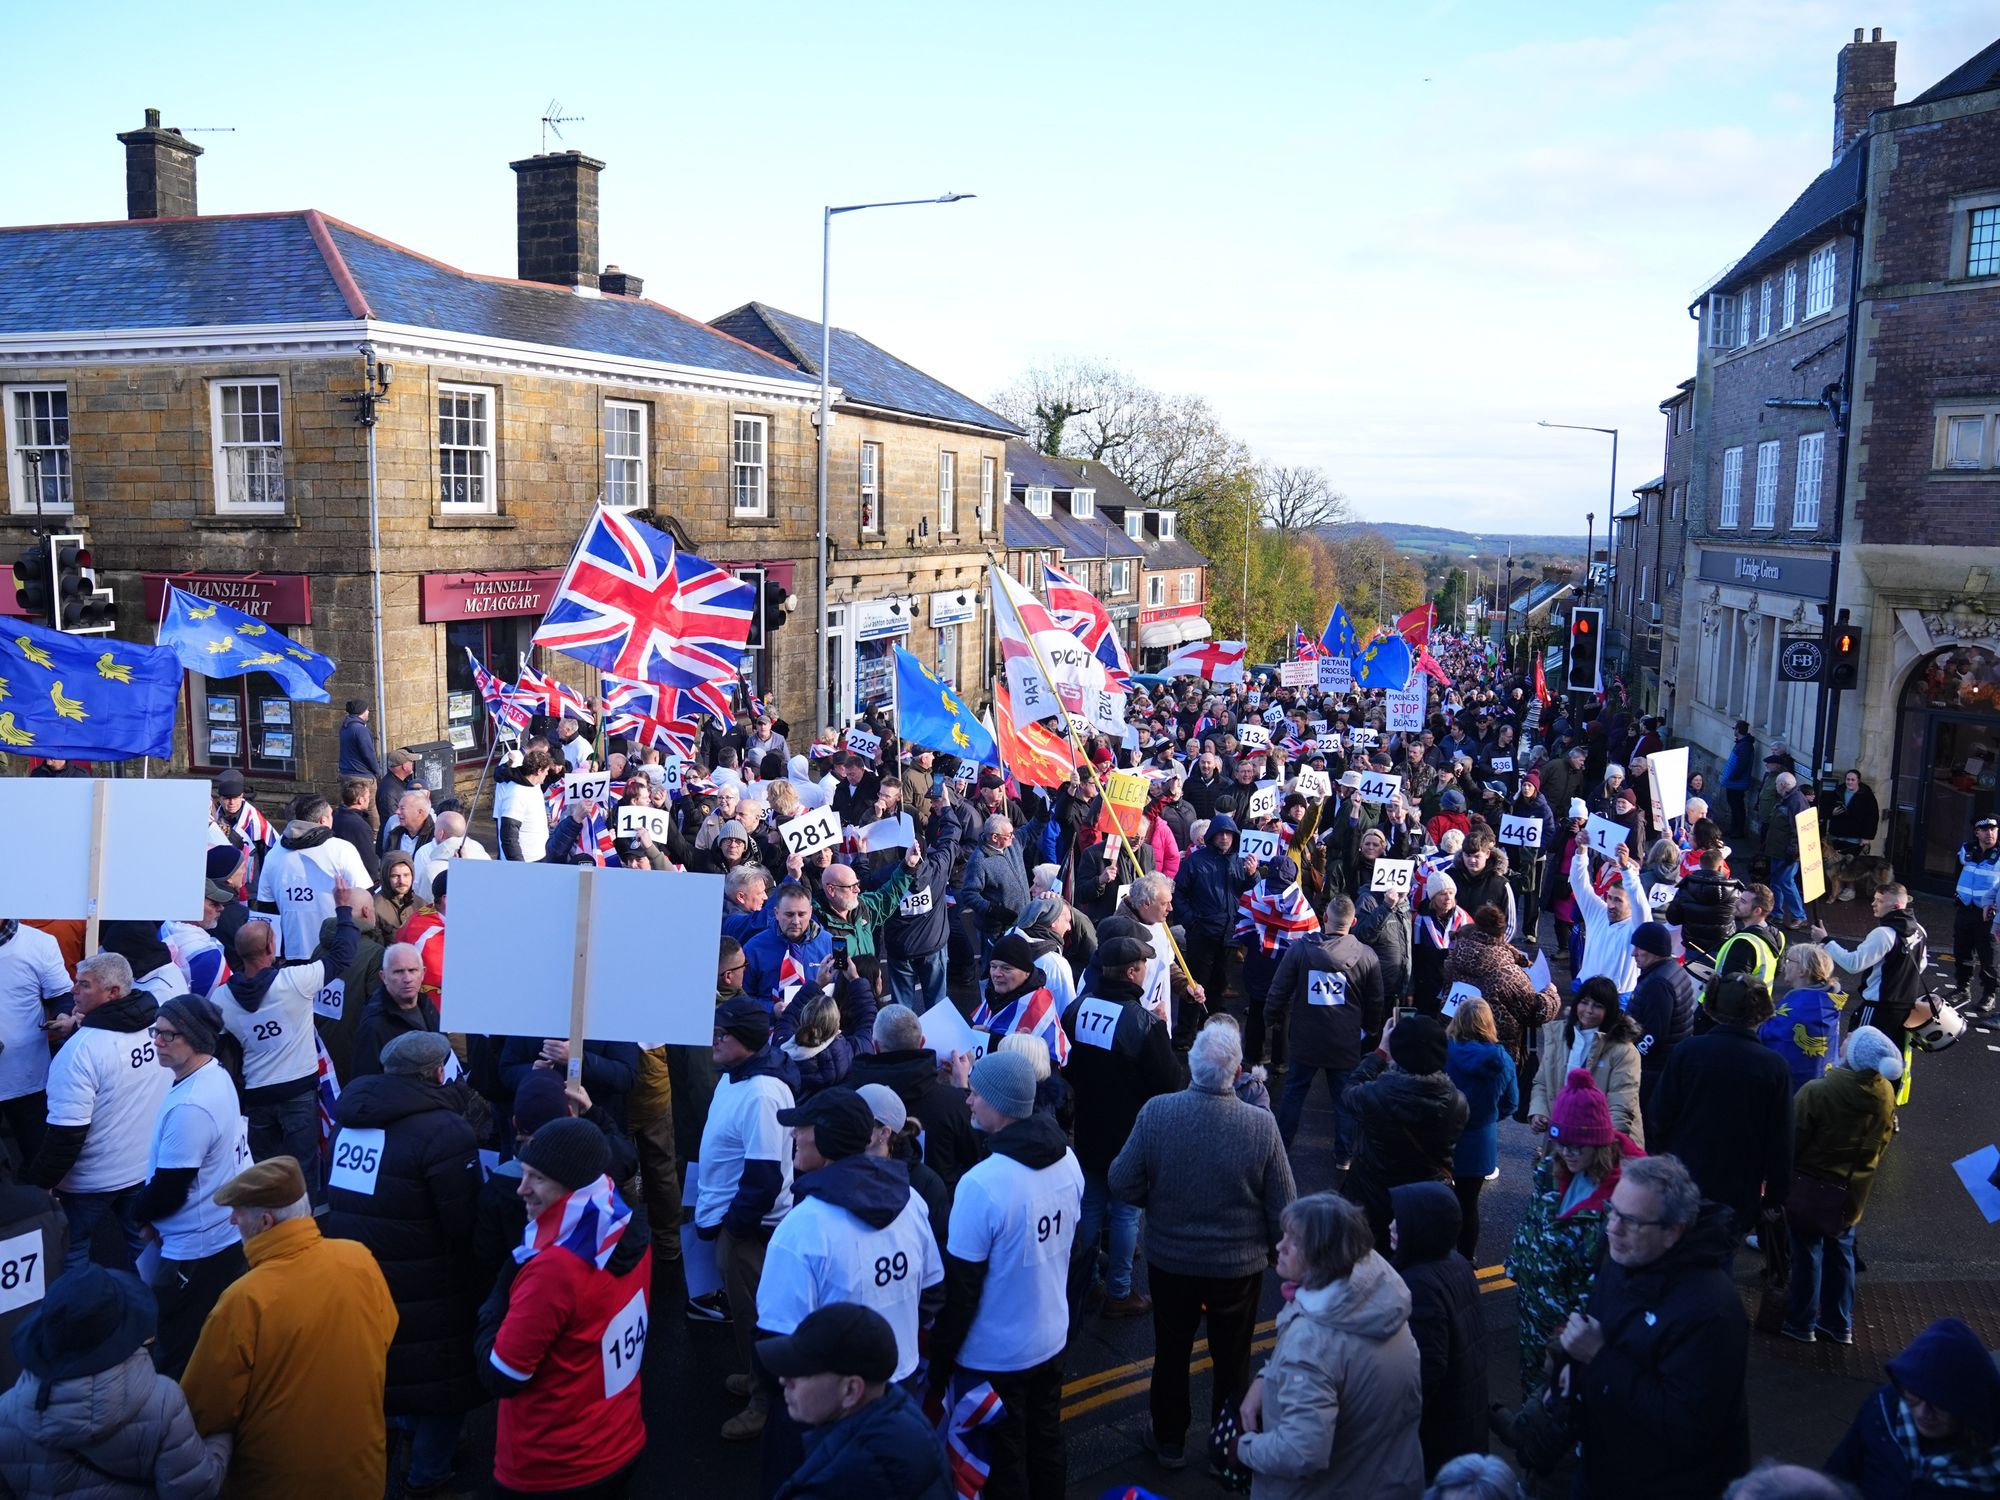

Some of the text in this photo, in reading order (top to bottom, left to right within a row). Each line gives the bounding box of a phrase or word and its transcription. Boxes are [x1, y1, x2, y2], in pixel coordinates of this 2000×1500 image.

[1761, 559, 1779, 579] Green
[187, 581, 261, 598] MANSELL
[471, 579, 533, 596] MANSELL
[463, 593, 541, 614] McTAGGART
[1321, 659, 1349, 667] DETAIN
[1321, 667, 1350, 676] PROCESS
[1320, 676, 1350, 685] DEPORT
[502, 703, 525, 722] OATS
[1265, 710, 1283, 723] 303
[1392, 704, 1419, 714] STOP
[1393, 718, 1419, 728] BOATS
[849, 734, 875, 755] 228
[1318, 740, 1339, 750] 223
[956, 764, 975, 781] 22
[568, 780, 607, 800] 167
[1360, 779, 1396, 799] 447
[622, 814, 664, 836] 116
[1502, 823, 1538, 843] 446
[788, 818, 835, 854] 281
[1242, 836, 1274, 856] 170
[1597, 829, 1606, 848] 1
[1374, 867, 1407, 886] 245
[285, 887, 314, 902] 123
[903, 894, 931, 910] 188
[1310, 980, 1343, 997] 412
[252, 1020, 283, 1041] 28
[1080, 1009, 1115, 1034] 177
[130, 1041, 156, 1069] 85
[336, 1142, 379, 1174] 295
[1037, 1209, 1063, 1243] 91
[1, 1252, 38, 1290] 87
[873, 1250, 909, 1288] 89
[608, 1315, 646, 1370] 154
